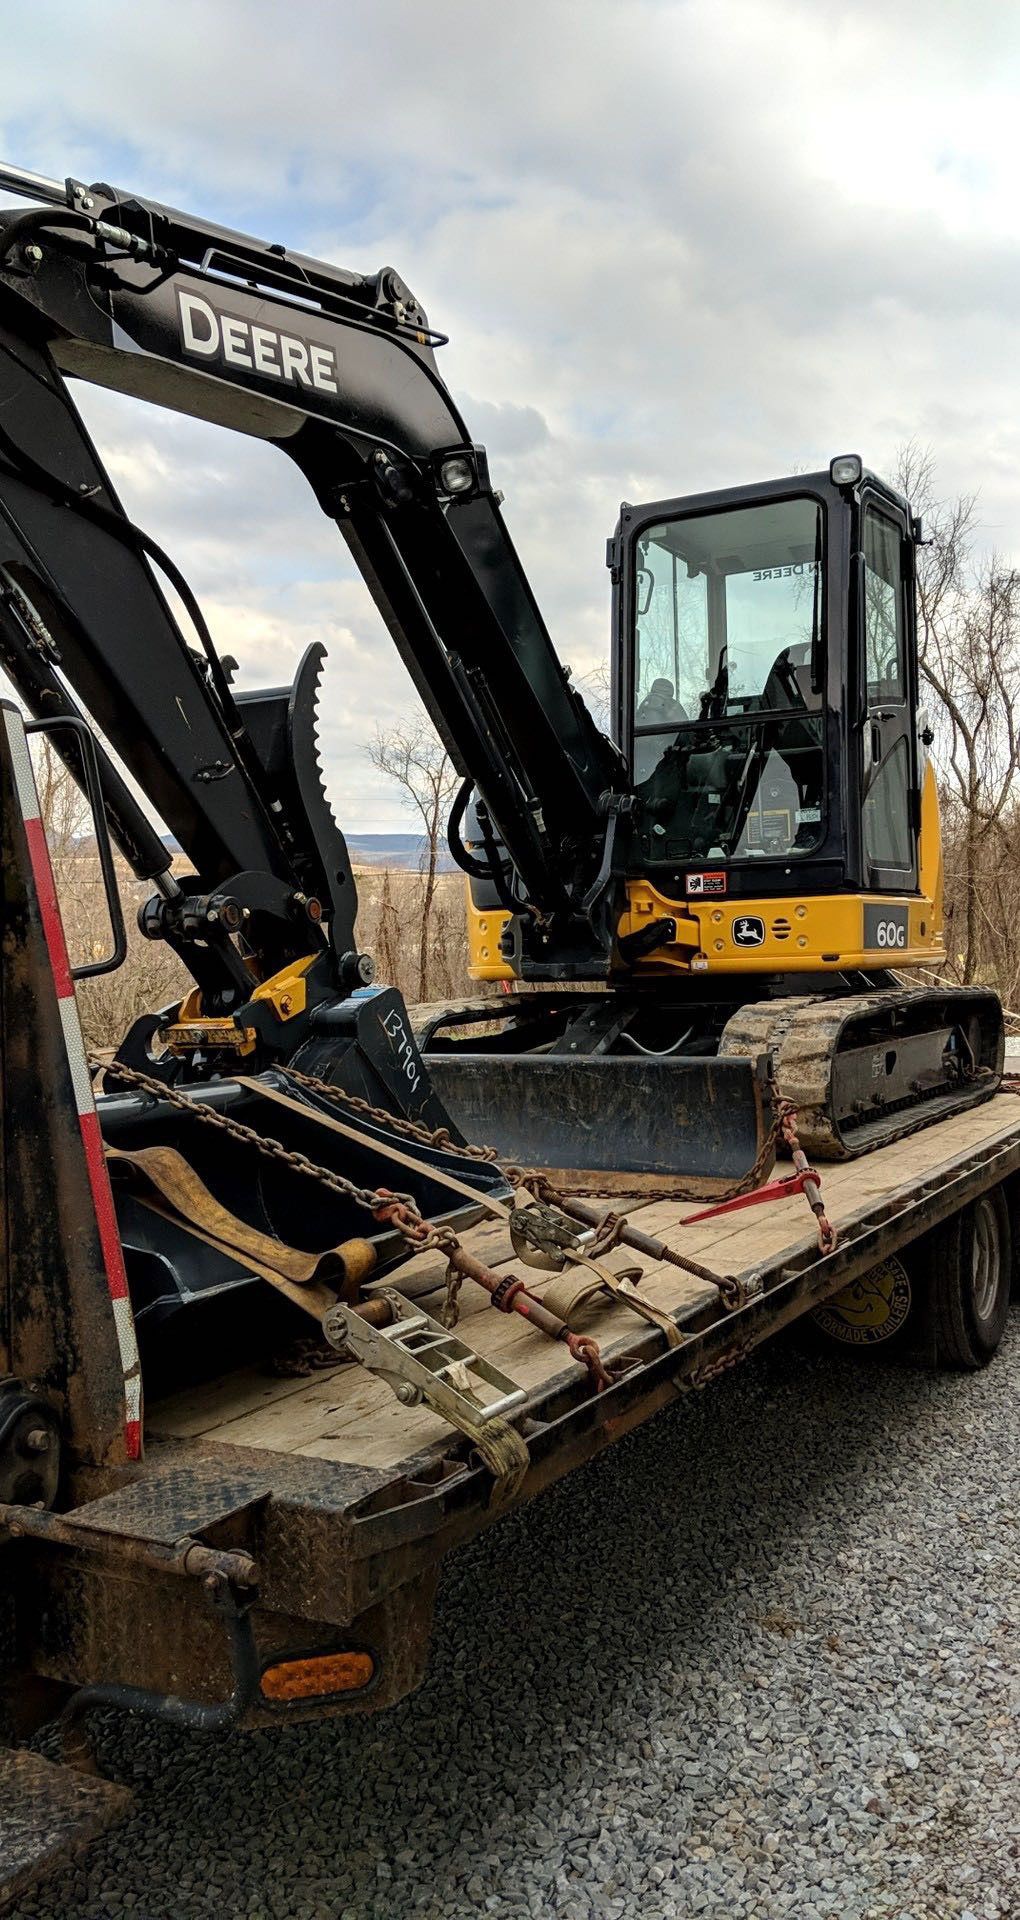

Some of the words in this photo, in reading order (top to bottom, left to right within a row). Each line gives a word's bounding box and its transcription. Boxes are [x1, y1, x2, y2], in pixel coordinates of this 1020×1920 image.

[178, 291, 338, 393] DEERE
[876, 920, 905, 947] 60G
[869, 1295, 908, 1340] TRAILERS
